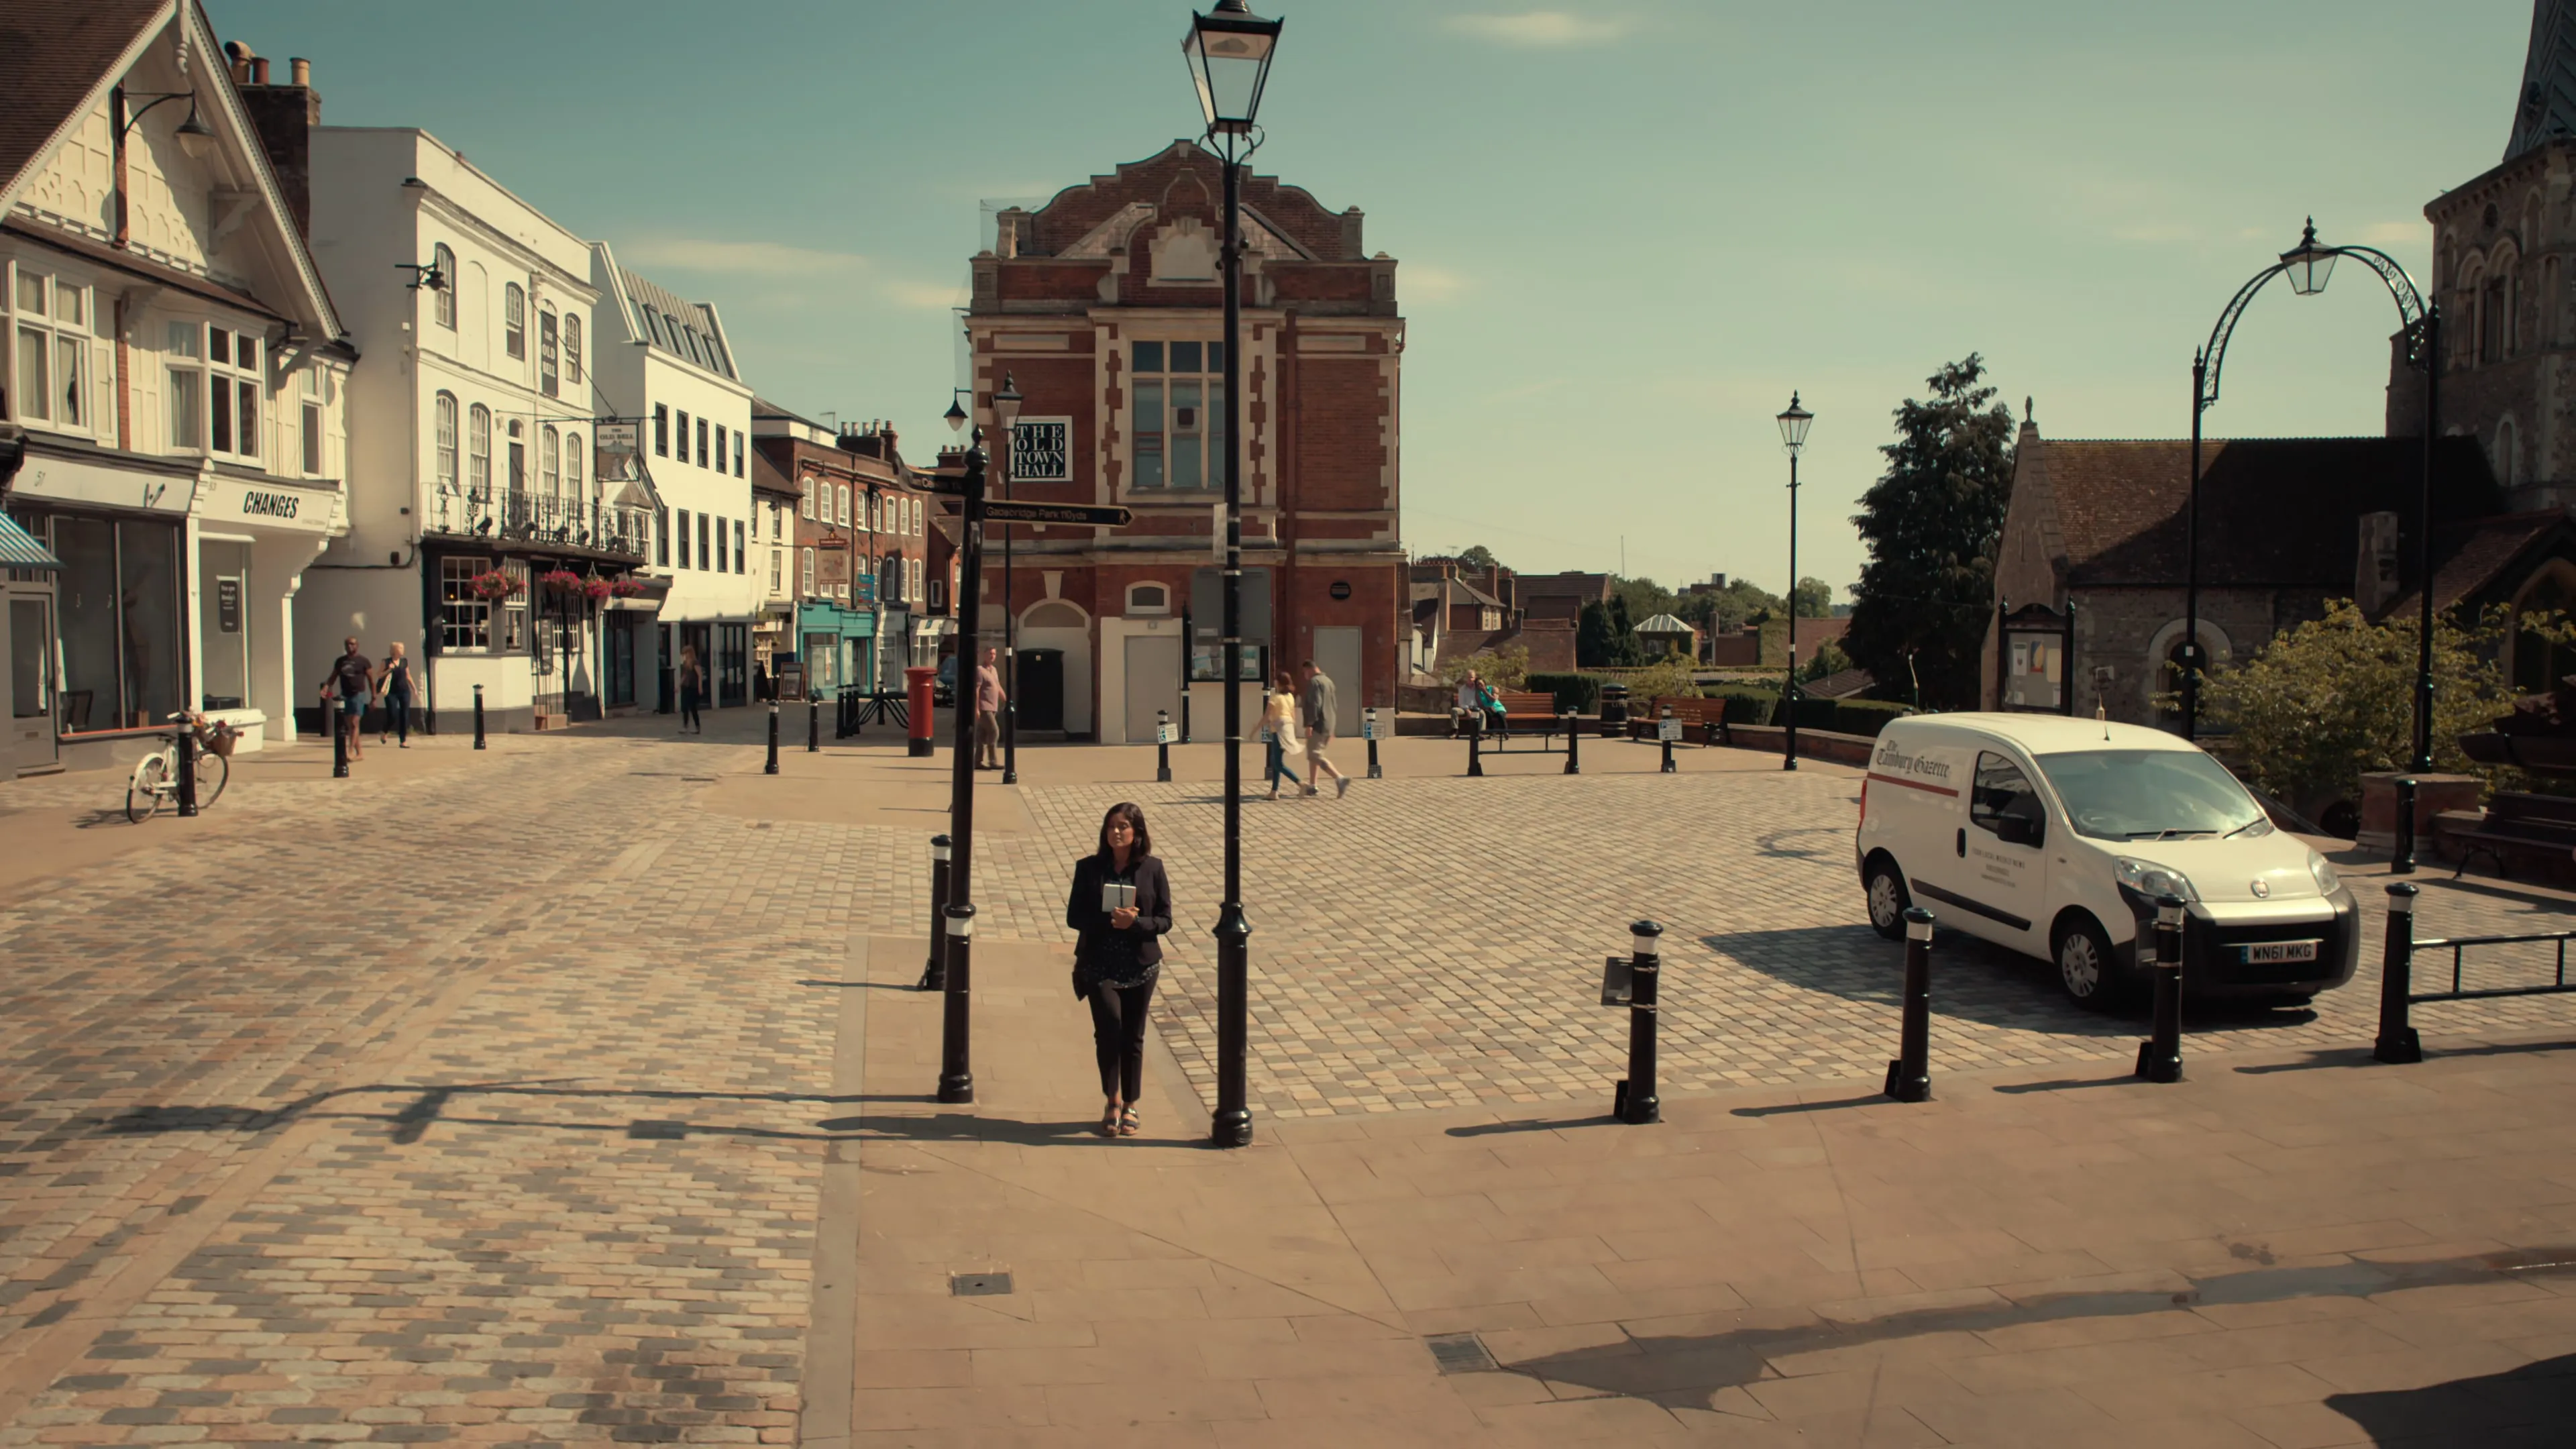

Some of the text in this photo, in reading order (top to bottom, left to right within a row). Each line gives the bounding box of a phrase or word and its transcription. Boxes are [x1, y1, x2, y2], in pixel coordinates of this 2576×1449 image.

[1016, 425, 1063, 438] THE
[1016, 439, 1063, 451] OLD
[1015, 451, 1065, 464] TOWN
[1018, 464, 1063, 476] HALL
[243, 491, 299, 519] CHANGES
[1039, 508, 1059, 519] Park
[1886, 739, 1898, 751] The
[1876, 748, 1950, 778] Tambury Gazette
[2253, 944, 2312, 960] WN61 MKG
